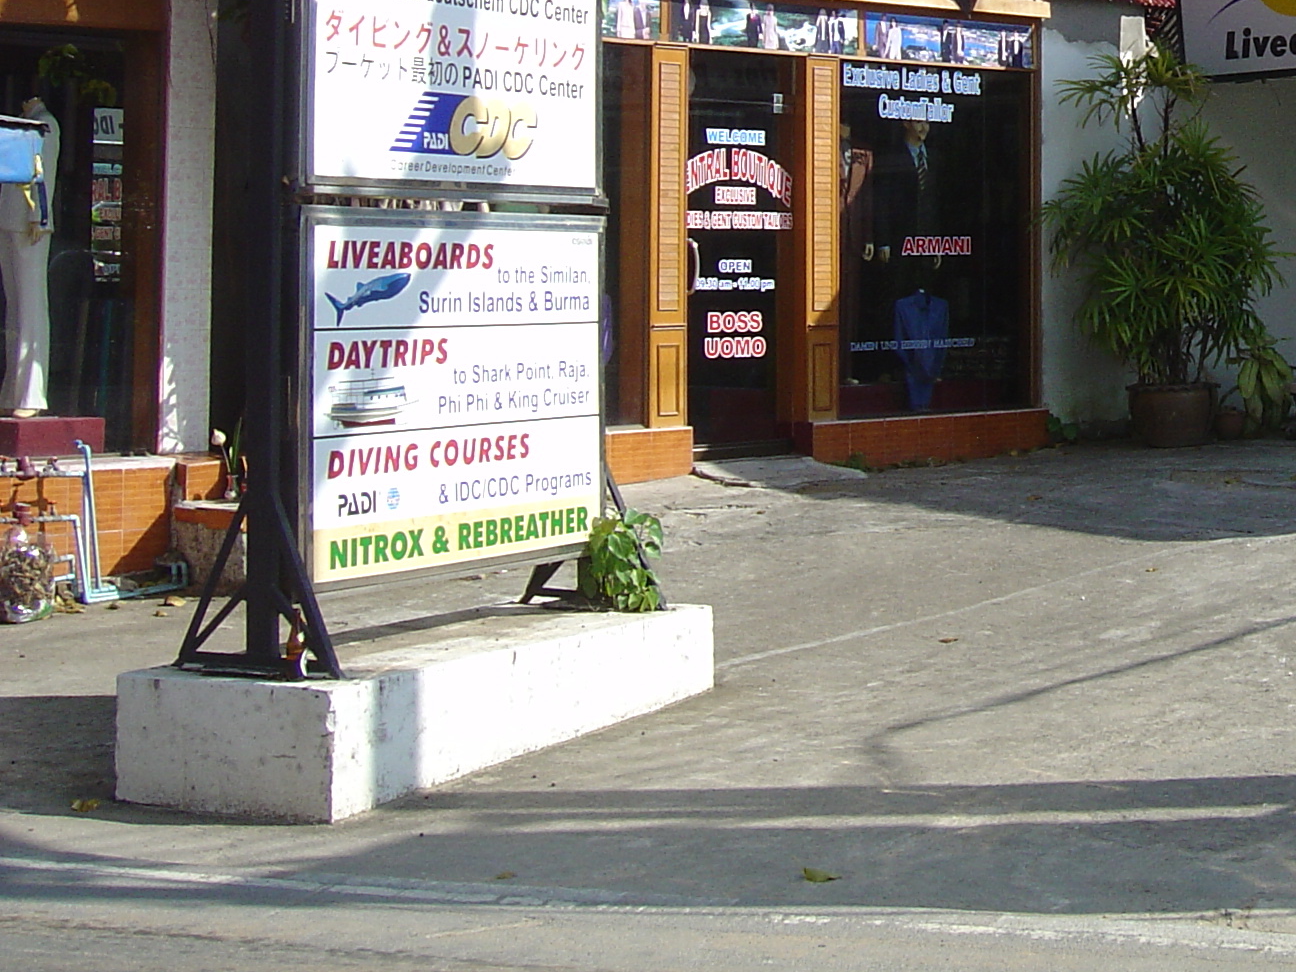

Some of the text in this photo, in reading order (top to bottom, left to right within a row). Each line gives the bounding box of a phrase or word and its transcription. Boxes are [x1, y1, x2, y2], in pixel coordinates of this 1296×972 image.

[545, 0, 588, 24] Center
[462, 66, 498, 91] PADI
[503, 72, 534, 94] CDC
[539, 74, 584, 100] Center
[843, 62, 981, 95] Exclusive Ladies & Gent
[450, 95, 538, 160] CDC
[706, 128, 766, 146] WELCOME
[424, 131, 449, 150] PADI
[425, 161, 485, 176] Development
[731, 148, 792, 208] BOUTIQUE
[715, 186, 756, 204] EXCLUSIVE
[711, 211, 732, 229] GENT
[732, 212, 763, 229] CUSTOM
[327, 239, 494, 270] LIVEABOARDS
[902, 236, 971, 256] ARMANI
[497, 268, 510, 284] to
[515, 267, 536, 284] the
[718, 259, 752, 273] OPEN
[419, 291, 590, 314] Surin Islands & Burma
[707, 311, 763, 333] BOSS
[327, 338, 448, 371] DAYTRIPS
[704, 336, 766, 359] UOMO
[453, 368, 466, 384] to
[472, 364, 511, 383] Shark
[438, 387, 589, 414] Phi Phi & King Cruiser
[327, 433, 530, 479] DIVING COURSES
[338, 471, 592, 517] PADI & IDC/CDC Programs
[329, 506, 588, 570] NITROX & REBREATHER
